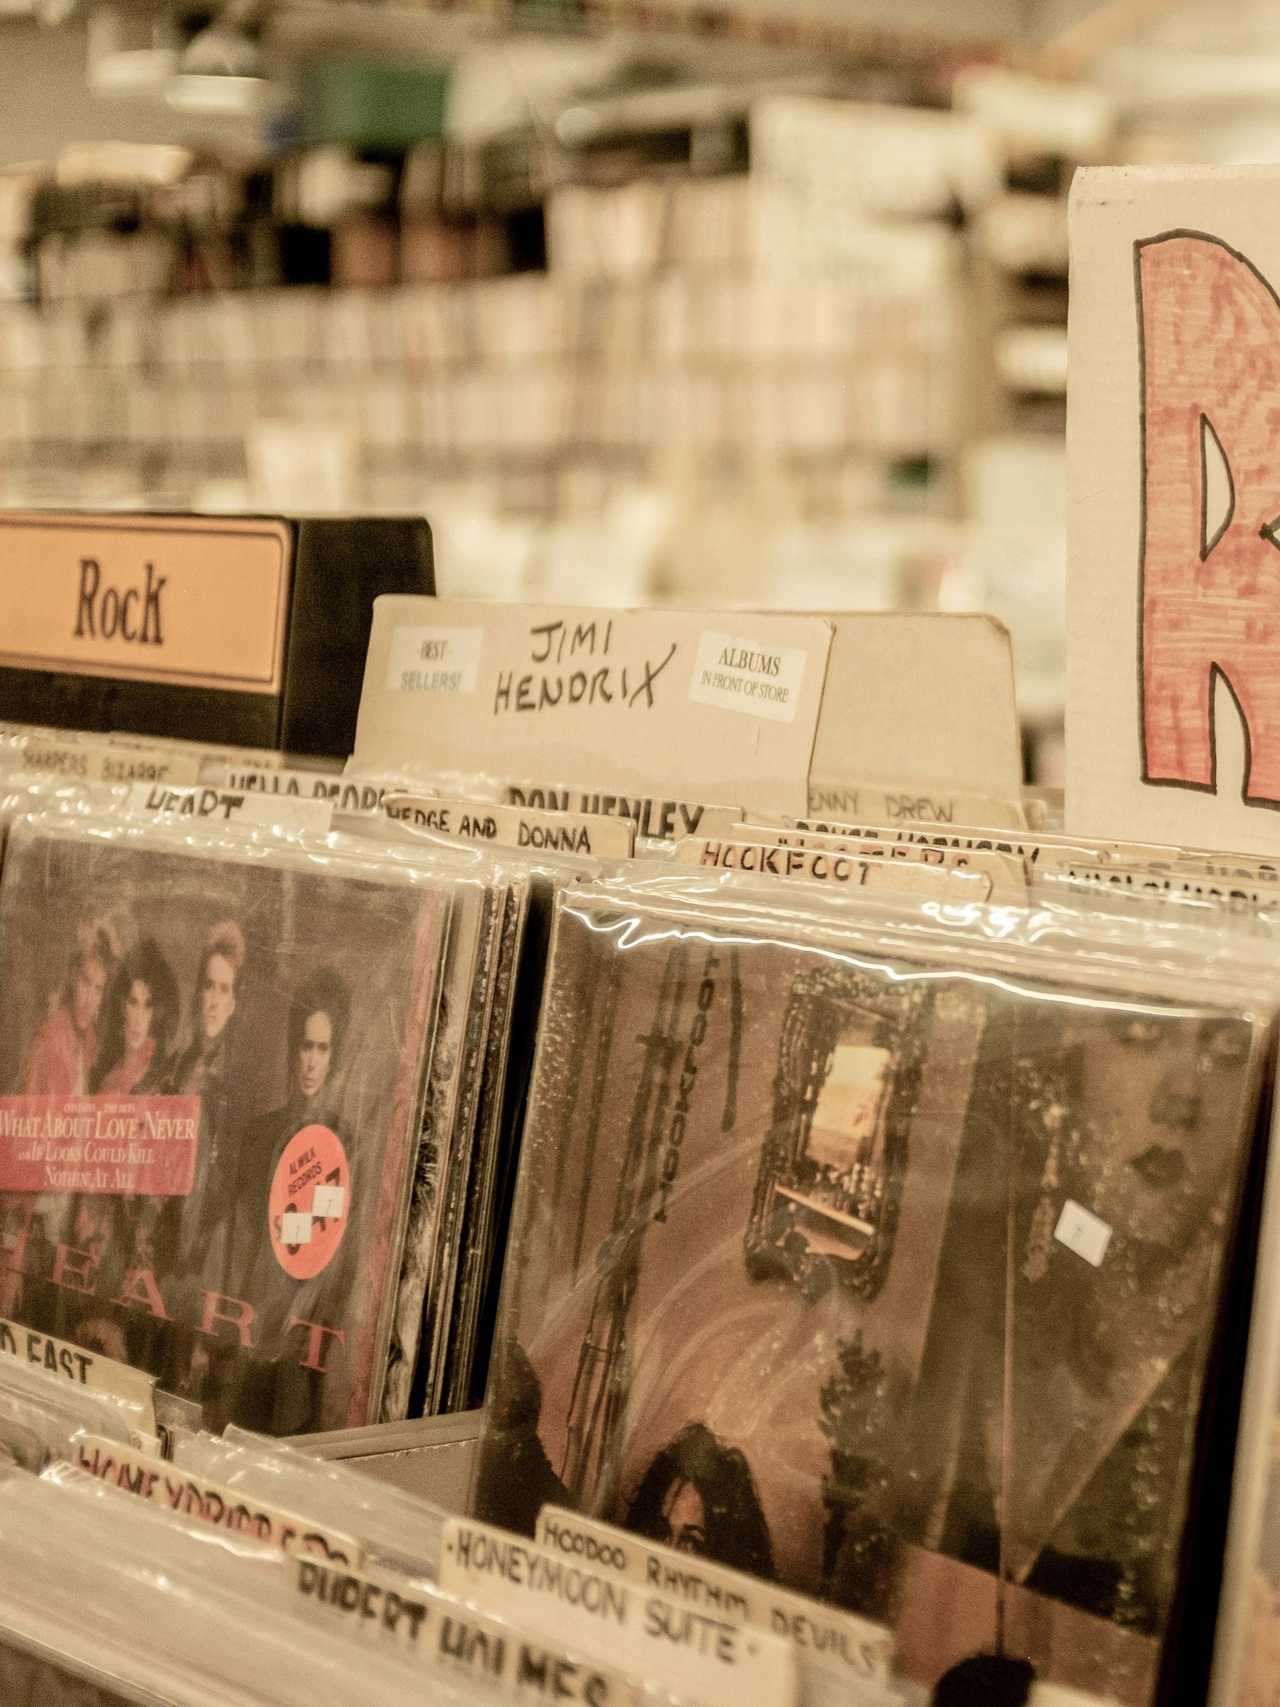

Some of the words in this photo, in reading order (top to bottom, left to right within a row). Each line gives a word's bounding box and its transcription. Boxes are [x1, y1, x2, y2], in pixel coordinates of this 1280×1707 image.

[73, 559, 167, 645] Rock
[530, 619, 613, 664] JIMI
[494, 642, 677, 715] HENDRIX
[717, 646, 782, 677] ALBUMS
[700, 670, 713, 685] IN
[712, 672, 744, 694] FRONT
[744, 680, 758, 696] OF
[758, 683, 789, 703] STORE
[808, 791, 859, 815] ENNY
[884, 794, 953, 823] DREW
[458, 815, 498, 839] AND
[517, 819, 592, 854] DONNA
[40, 1110, 94, 1139] ABOUT
[95, 1111, 138, 1140] LOVE
[143, 1110, 196, 1140] NEVER
[83, 1140, 126, 1164] COULD
[286, 1160, 323, 1197] RECORDS
[26, 1332, 94, 1385] EAST
[543, 1517, 628, 1571] HOODOO
[646, 1555, 751, 1623] RHYTHM
[770, 1606, 877, 1681] DEVILS
